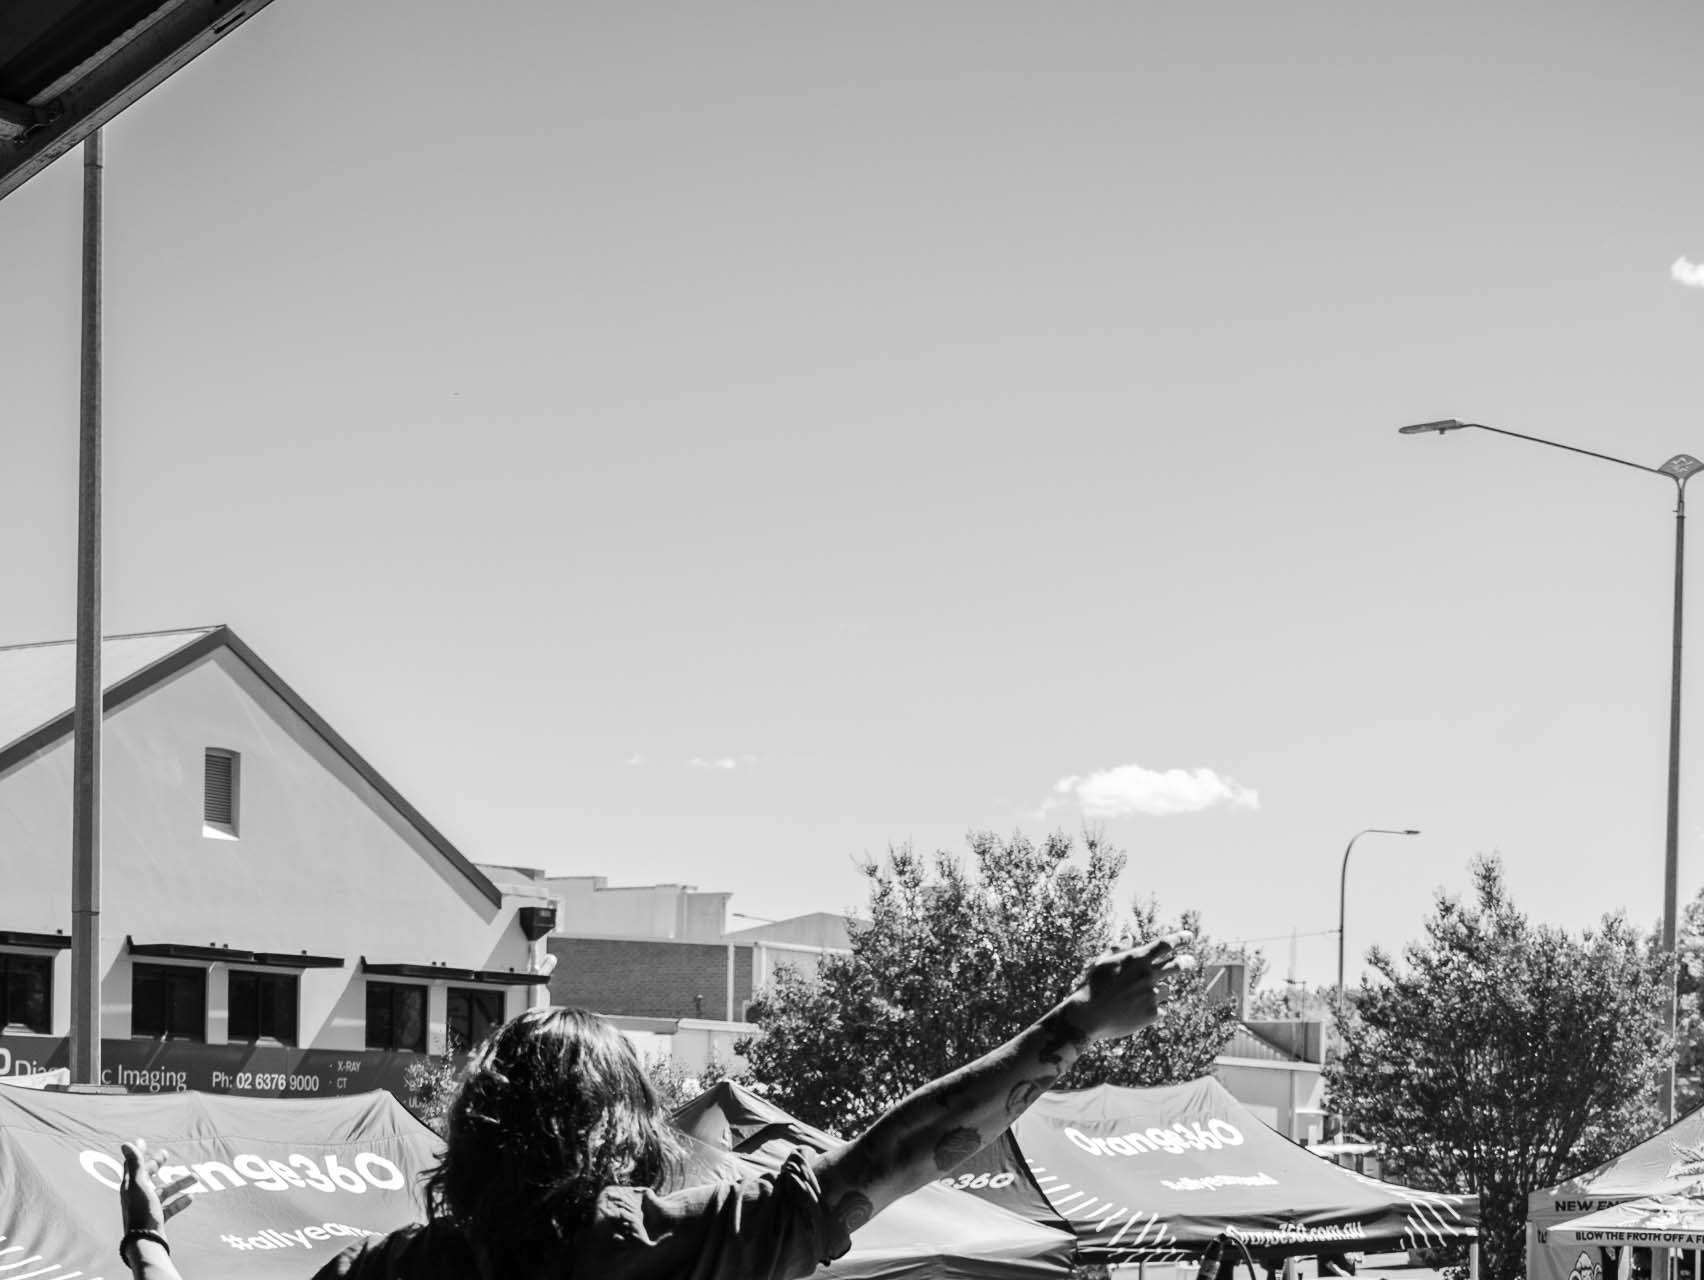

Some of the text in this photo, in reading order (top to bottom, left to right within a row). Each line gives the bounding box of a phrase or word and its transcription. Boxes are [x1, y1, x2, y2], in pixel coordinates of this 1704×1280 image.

[337, 1060, 361, 1072] X-RAY
[117, 1064, 188, 1093] Imaging
[212, 1071, 320, 1092] Ph: 02 6376 9000
[336, 1077, 347, 1089] CT
[1064, 1118, 1244, 1156] Orange360
[79, 1150, 405, 1195] Oange360
[1555, 1200, 1593, 1212] NEW
[1605, 1231, 1625, 1241] THE
[1627, 1231, 1661, 1242] FROTH
[1663, 1233, 1685, 1243] OFF
[1686, 1234, 1694, 1244] A
